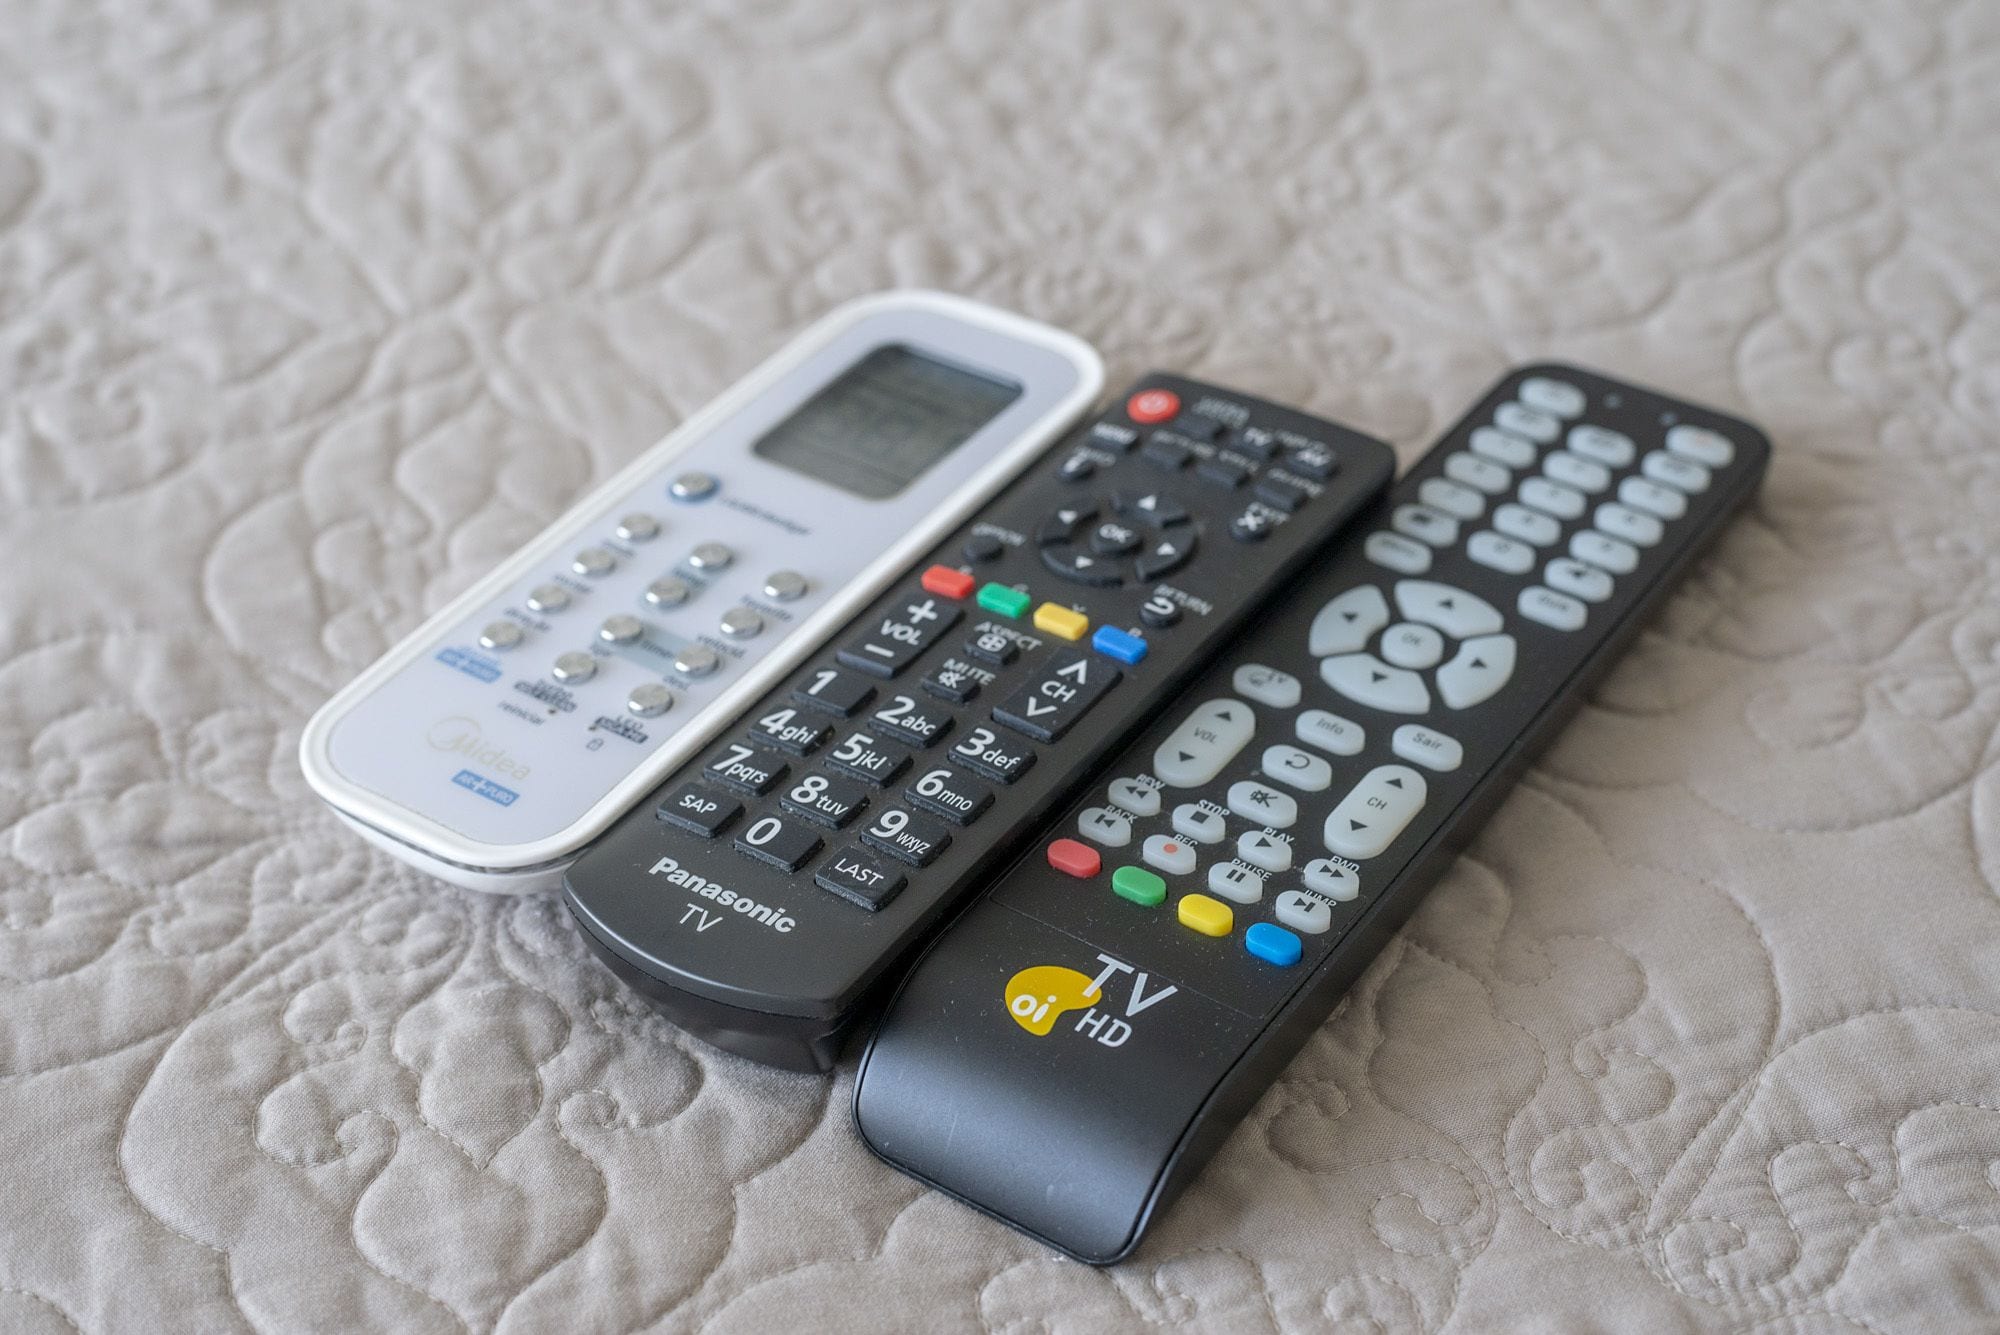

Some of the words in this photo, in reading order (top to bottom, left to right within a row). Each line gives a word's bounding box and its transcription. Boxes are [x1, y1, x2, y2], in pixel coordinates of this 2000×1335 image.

[880, 619, 923, 645] VOL
[808, 670, 838, 695] 1
[1041, 680, 1076, 703] CH
[1194, 727, 1217, 744] VOL
[1316, 718, 1345, 735] Info
[1412, 732, 1442, 751] Sair
[444, 728, 531, 781] Midea
[679, 794, 717, 814] SAP
[1104, 804, 1138, 825] BACK
[1196, 799, 1231, 817] STOP
[1367, 797, 1388, 811] CH
[745, 818, 782, 846] 0
[1262, 827, 1295, 845] PLAY
[834, 858, 884, 887] LAST
[1231, 857, 1272, 883] PAUSE
[648, 857, 796, 934] Panasonic
[678, 903, 724, 933] TV
[1011, 994, 1056, 1023] oi
[1083, 953, 1178, 1017] TV
[1074, 1008, 1132, 1048] HD
